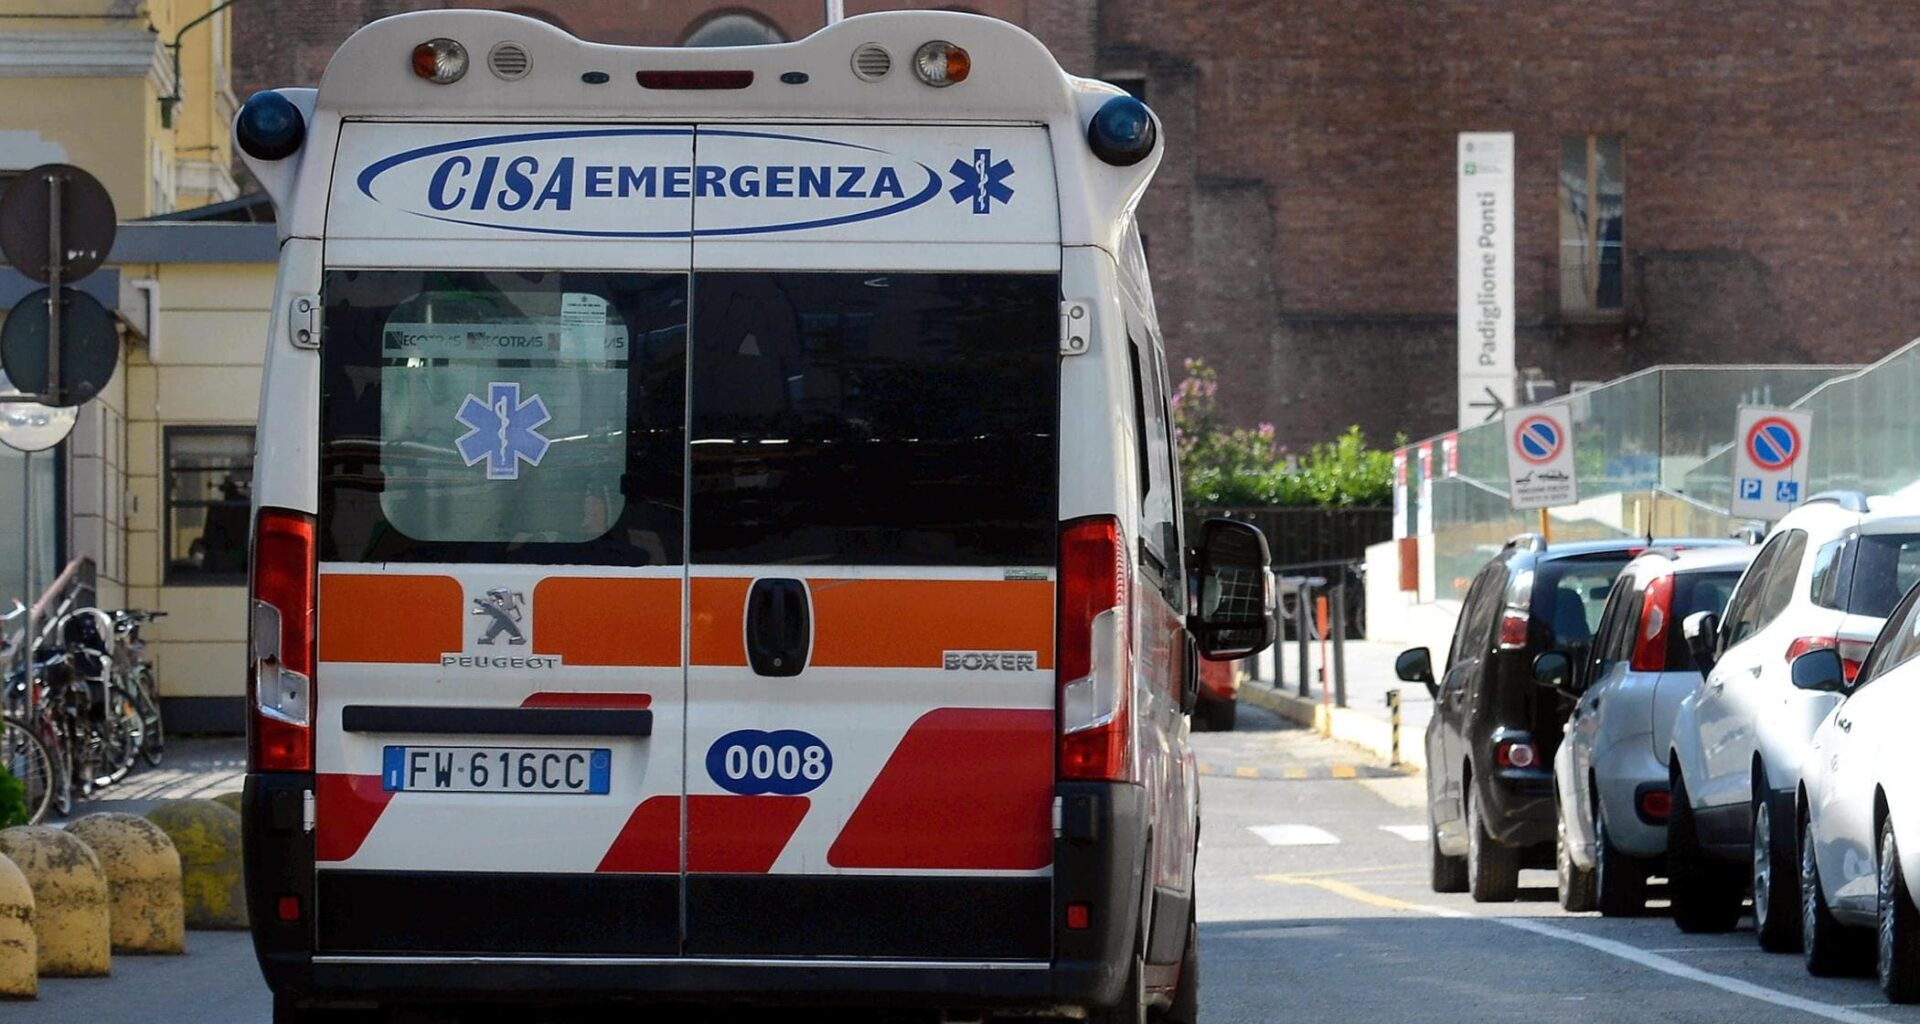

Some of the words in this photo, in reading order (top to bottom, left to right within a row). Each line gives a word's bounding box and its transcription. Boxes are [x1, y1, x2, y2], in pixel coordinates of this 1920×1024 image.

[427, 155, 575, 211] CISA
[584, 165, 906, 199] EMERGENZA
[1477, 191, 1497, 248] Ponti
[1477, 253, 1502, 367] Padiglione
[442, 655, 558, 669] PEUGEOT
[944, 653, 1034, 671] BOXER
[725, 744, 826, 780] 0008
